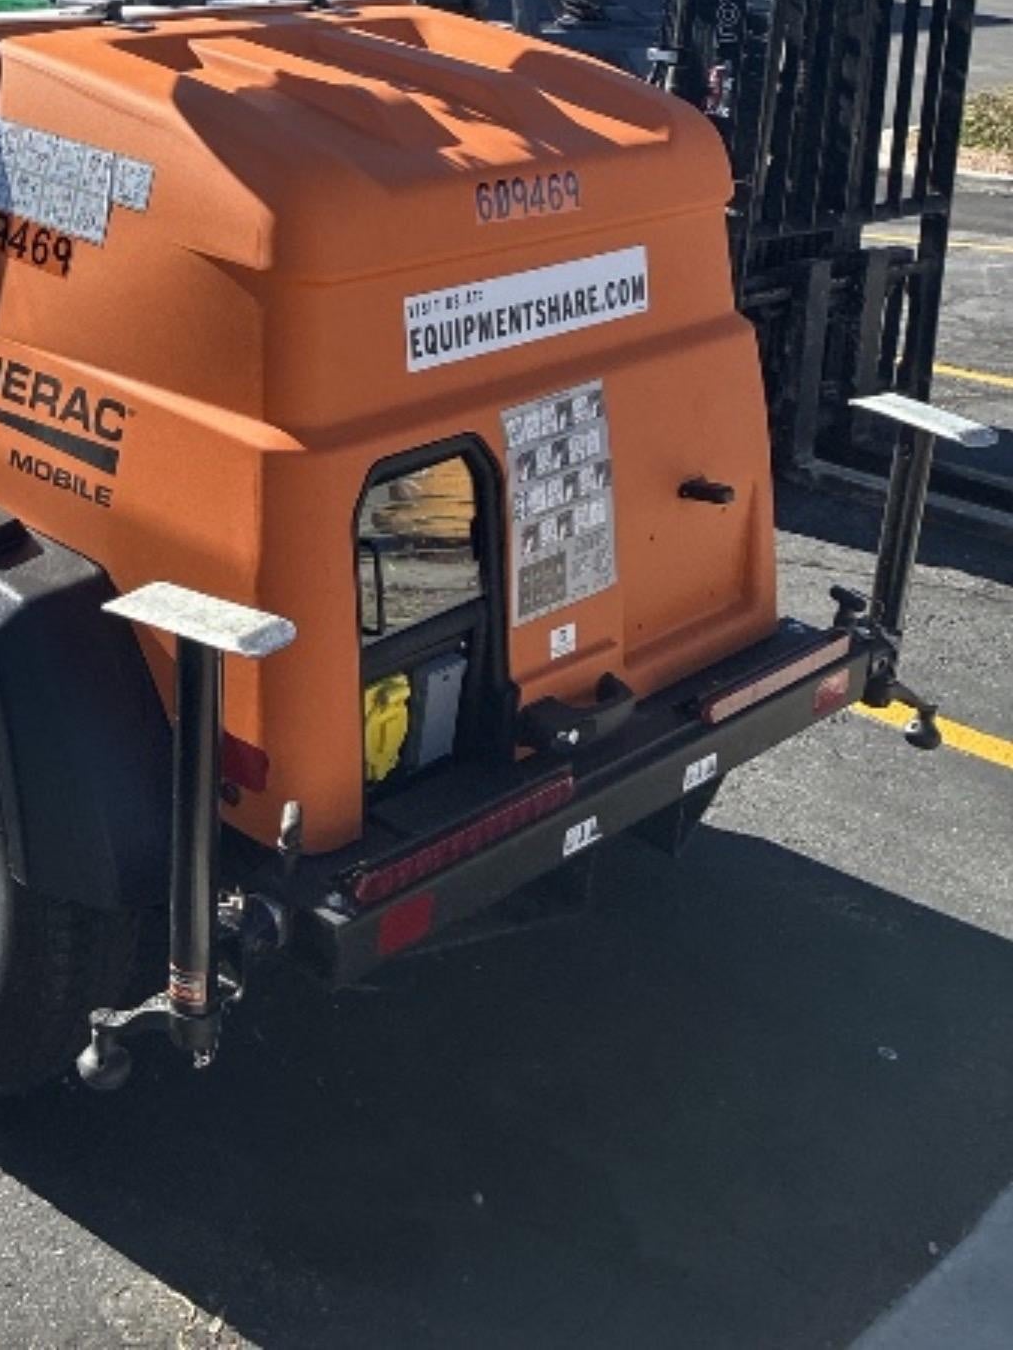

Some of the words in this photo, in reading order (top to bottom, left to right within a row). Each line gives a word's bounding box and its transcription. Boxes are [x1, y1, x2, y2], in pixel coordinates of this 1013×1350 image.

[475, 170, 580, 222] 609469
[409, 274, 645, 359] EQUIPMENTSHARE.COM
[9, 449, 114, 507] MOBILE
